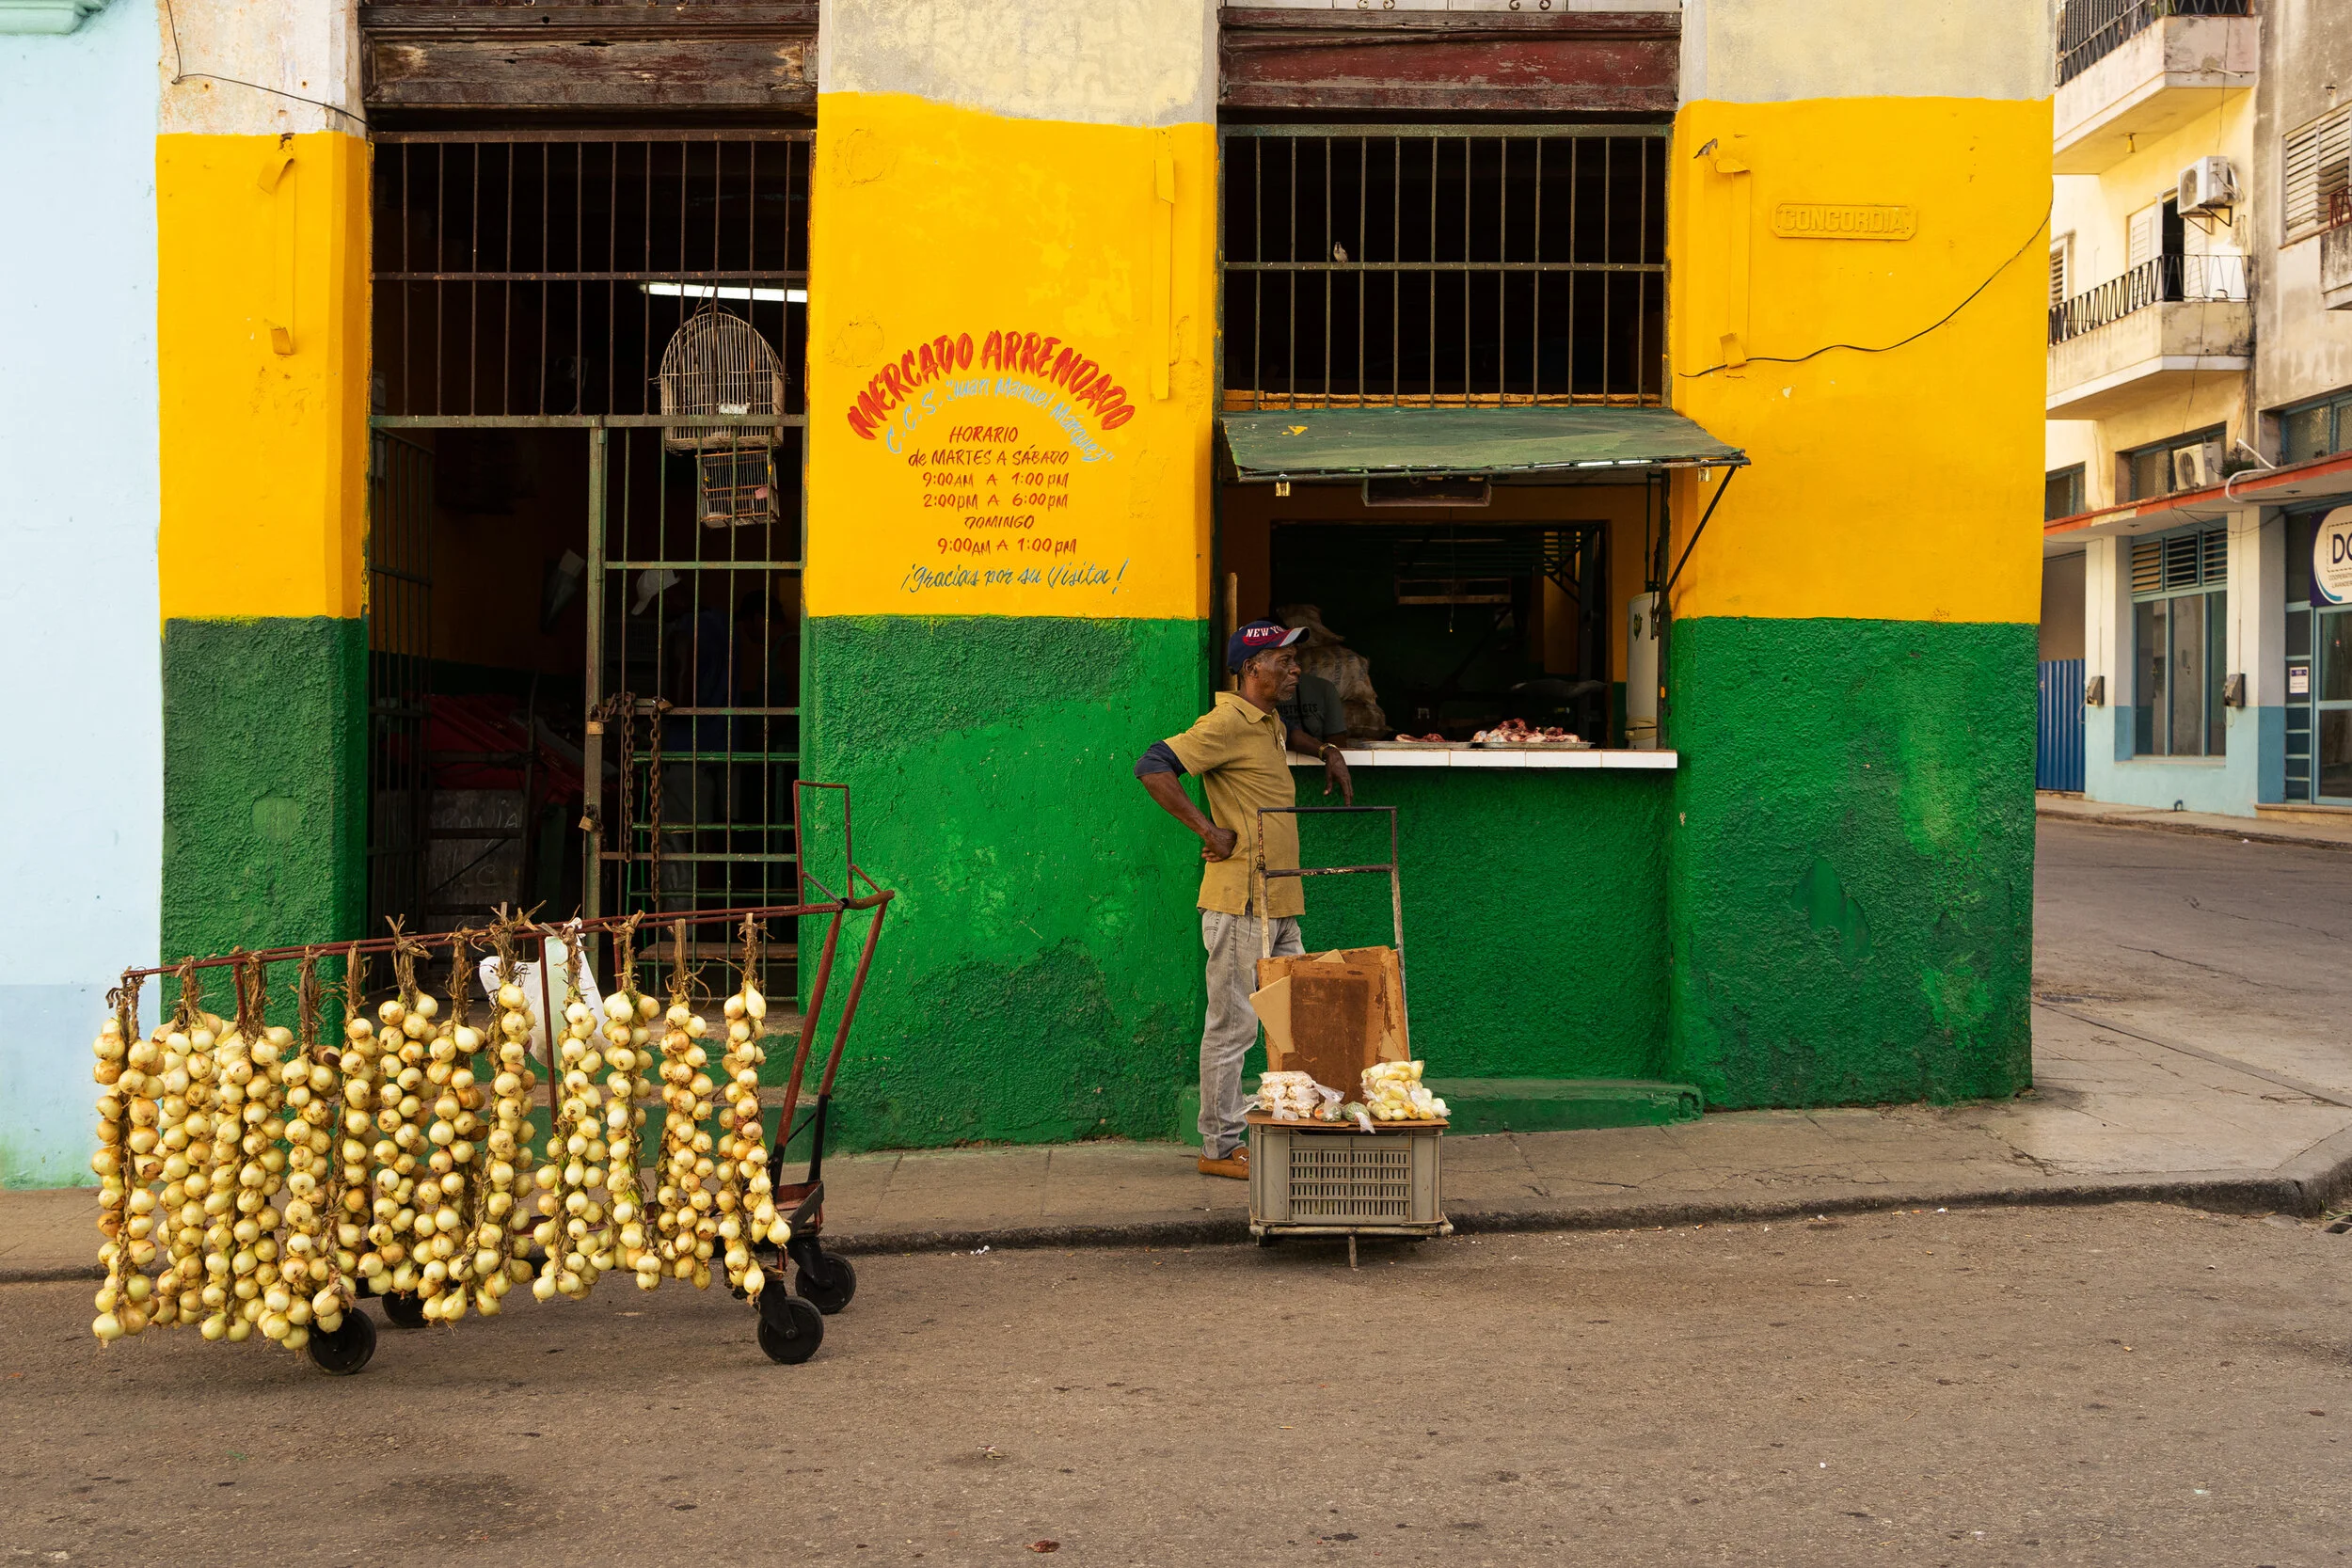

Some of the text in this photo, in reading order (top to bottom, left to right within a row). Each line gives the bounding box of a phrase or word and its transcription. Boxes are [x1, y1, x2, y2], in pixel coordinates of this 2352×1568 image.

[1782, 208, 1906, 234] CONCORDIA
[847, 329, 1136, 440] MERCADO ARRENDADO
[994, 376, 1056, 410] Manuel
[948, 426, 1018, 443] HORARIO
[908, 444, 1069, 467] de MARTES A SÁBADO
[986, 473, 998, 486] A
[988, 493, 999, 507] A
[964, 515, 1035, 530] DOMINGO
[995, 538, 1009, 551] A
[984, 565, 1013, 587] por
[1017, 565, 1041, 585] su
[1246, 627, 1269, 638] NEW
